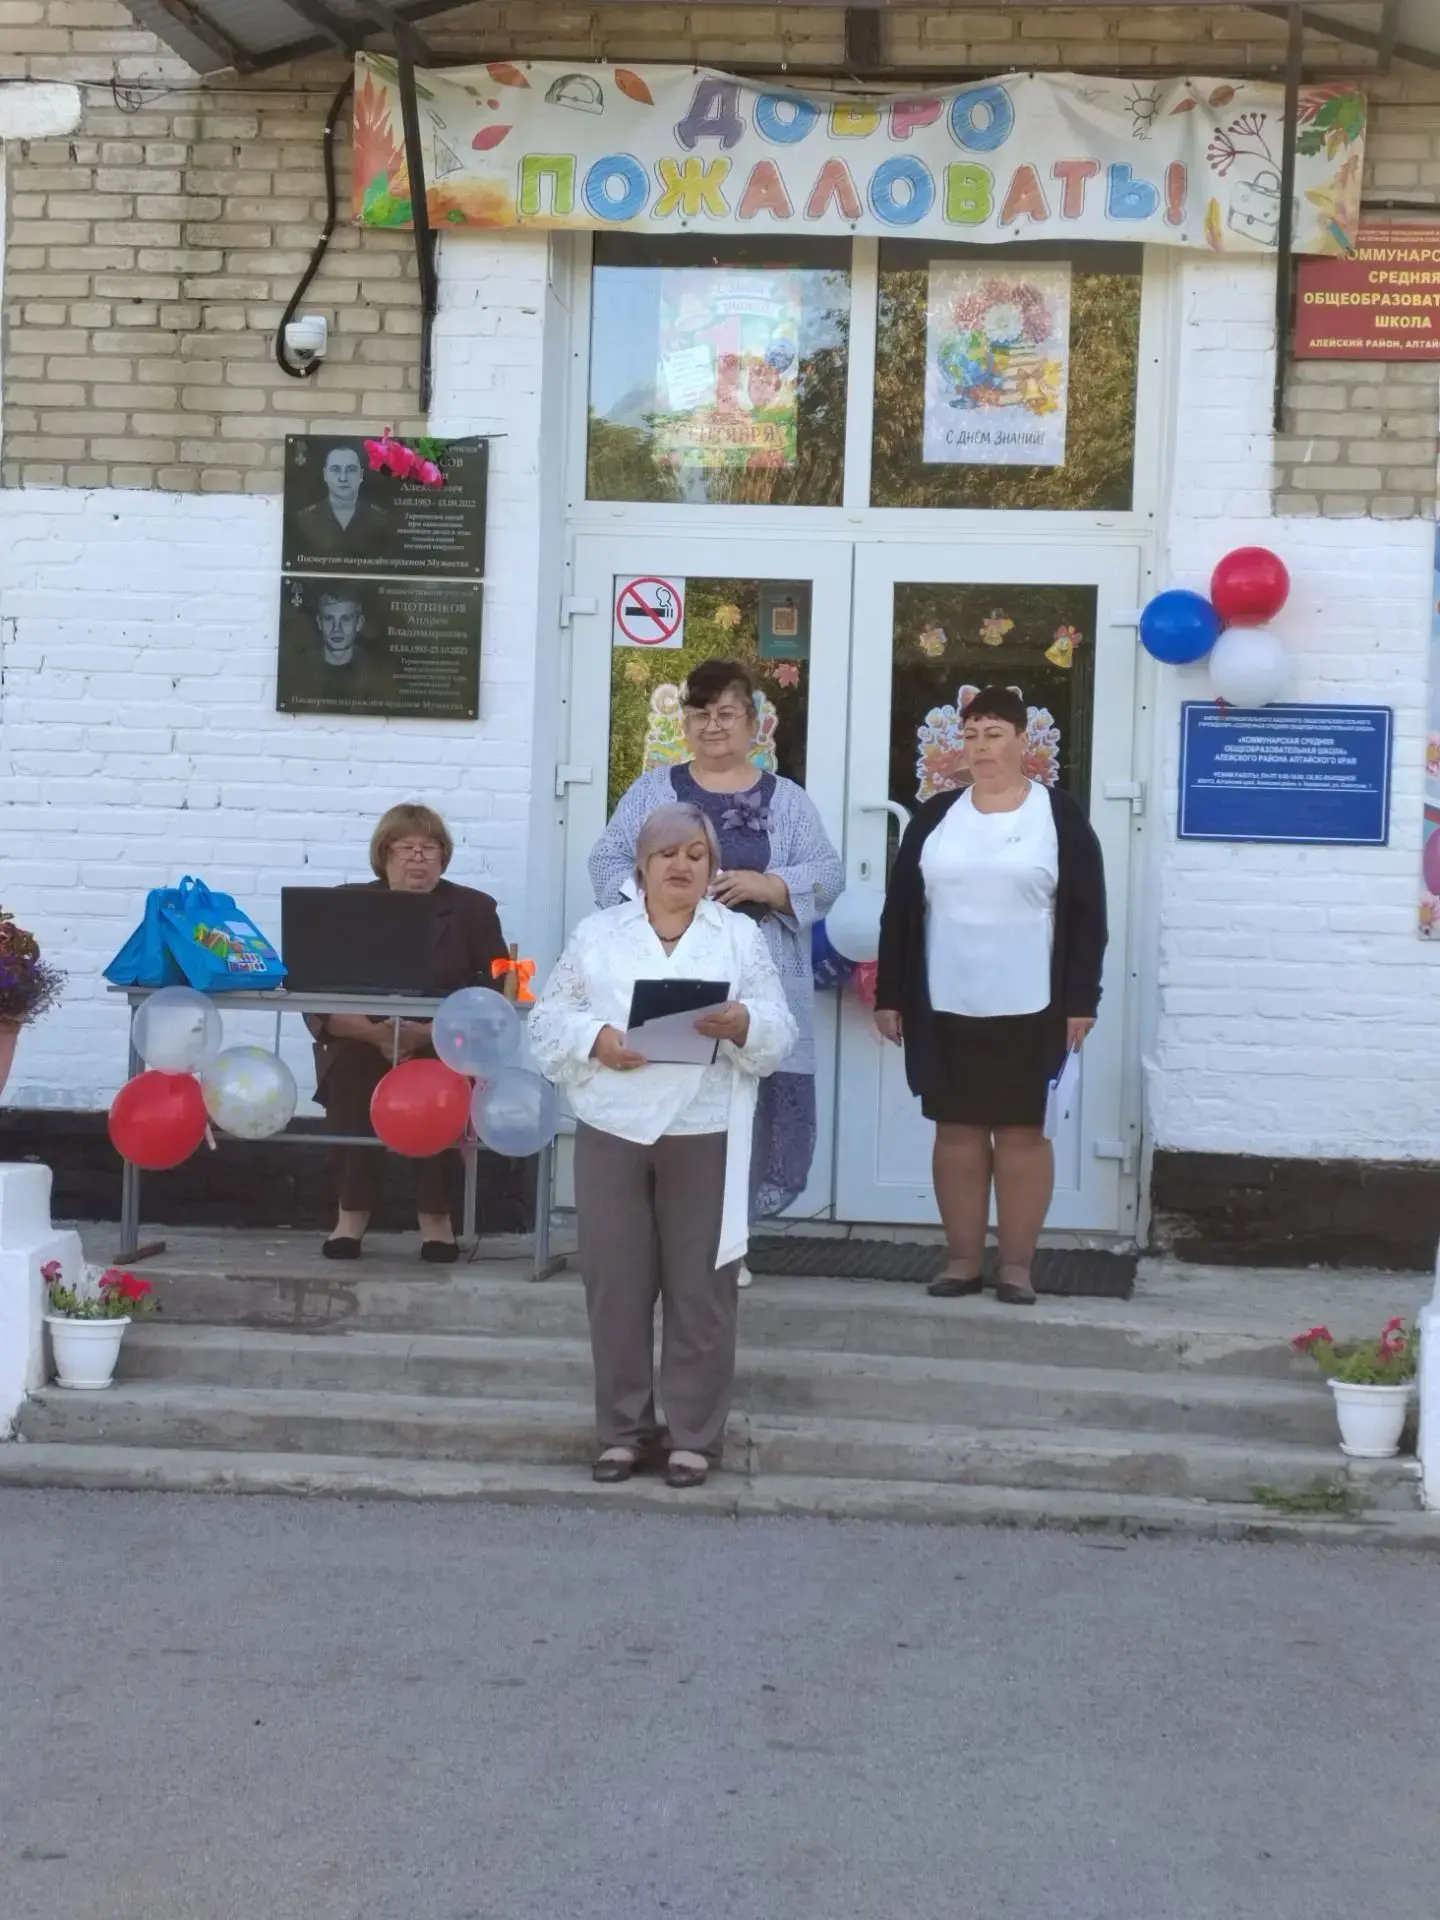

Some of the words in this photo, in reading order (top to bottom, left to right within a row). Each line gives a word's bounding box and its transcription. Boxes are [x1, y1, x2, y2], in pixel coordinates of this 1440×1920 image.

[674, 76, 1014, 152] ДОБРО
[516, 153, 1188, 229] ПОЖАЛОВАТЬ!
[1368, 271, 1440, 285] СРЕДНЯЯ
[1375, 315, 1432, 328] ШКОЛА
[1309, 338, 1363, 348] АЛЕЙСКИЙ
[1365, 339, 1403, 349] РАЙОН,
[946, 429, 954, 444] С
[993, 430, 1045, 446] ЗНАНИЙ!
